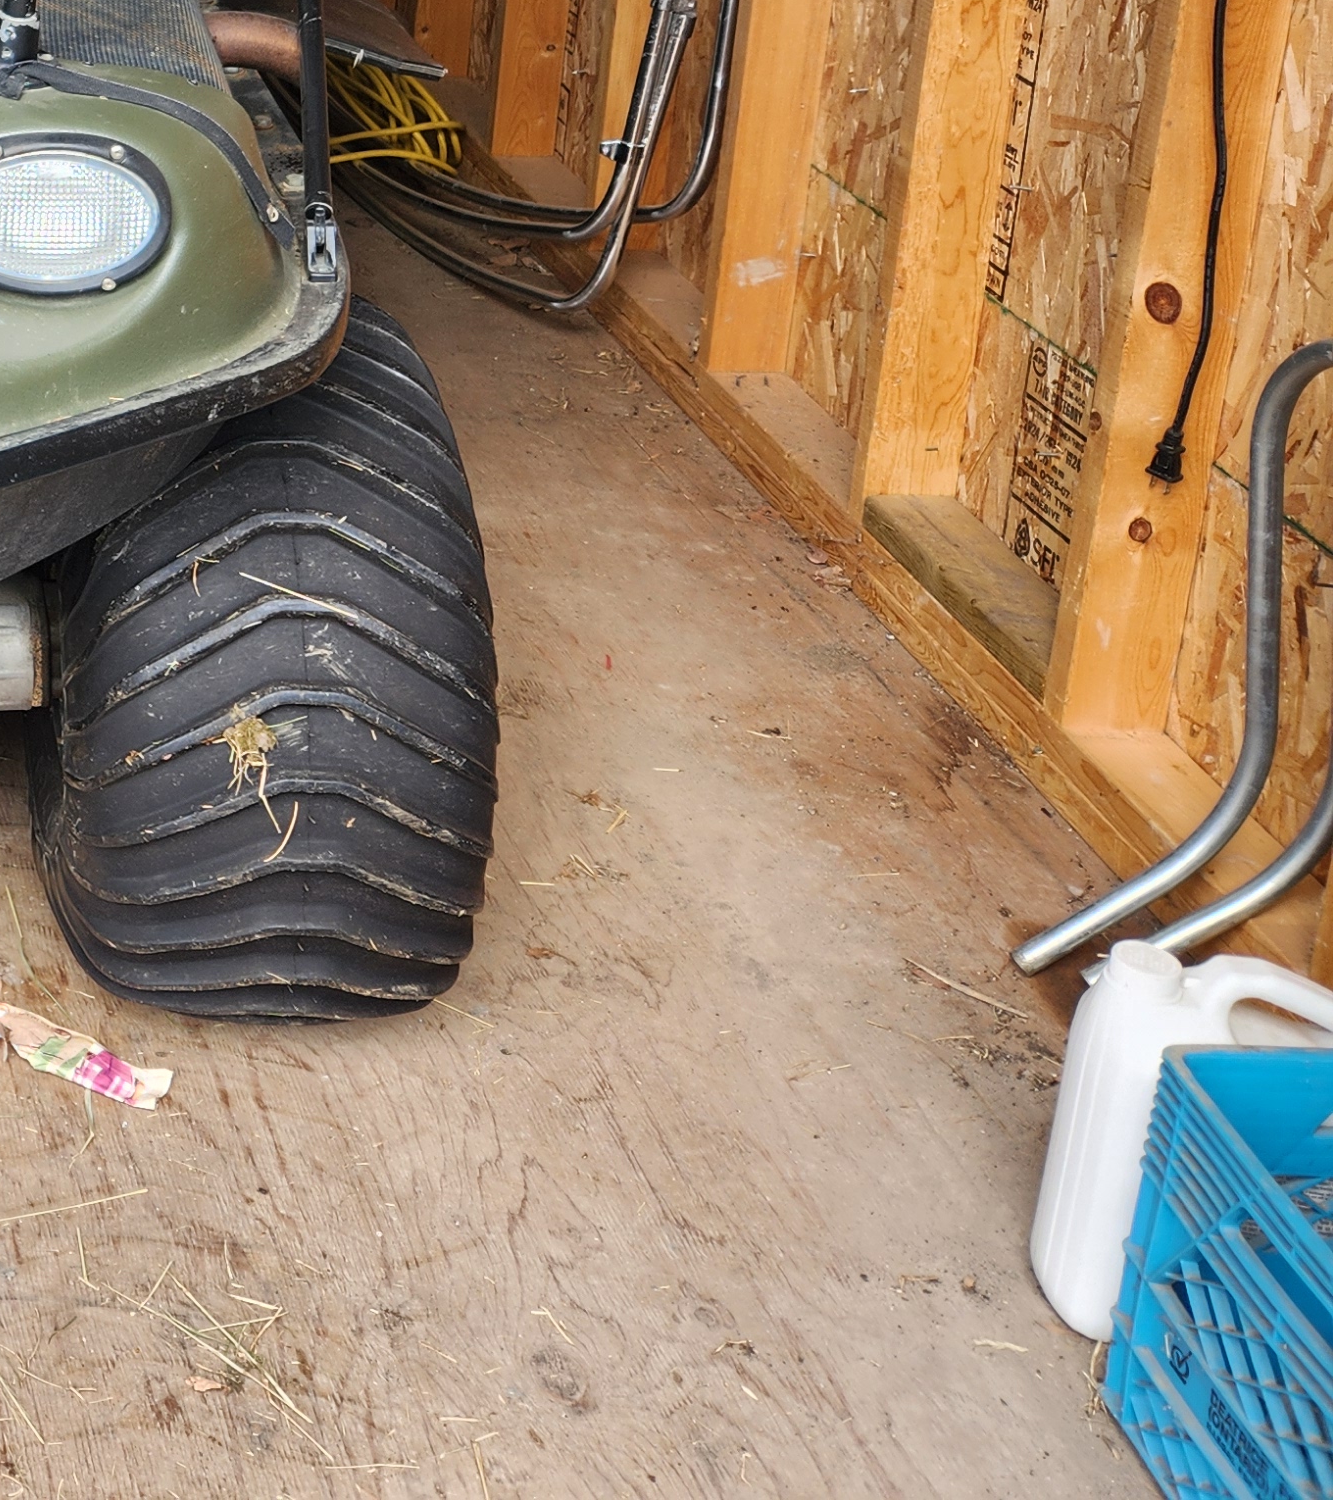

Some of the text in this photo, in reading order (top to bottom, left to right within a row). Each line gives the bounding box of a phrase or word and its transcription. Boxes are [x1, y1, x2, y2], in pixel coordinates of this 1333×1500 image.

[1023, 455, 1038, 475] CSA
[1016, 466, 1074, 519] EXTERIOR TYPE
